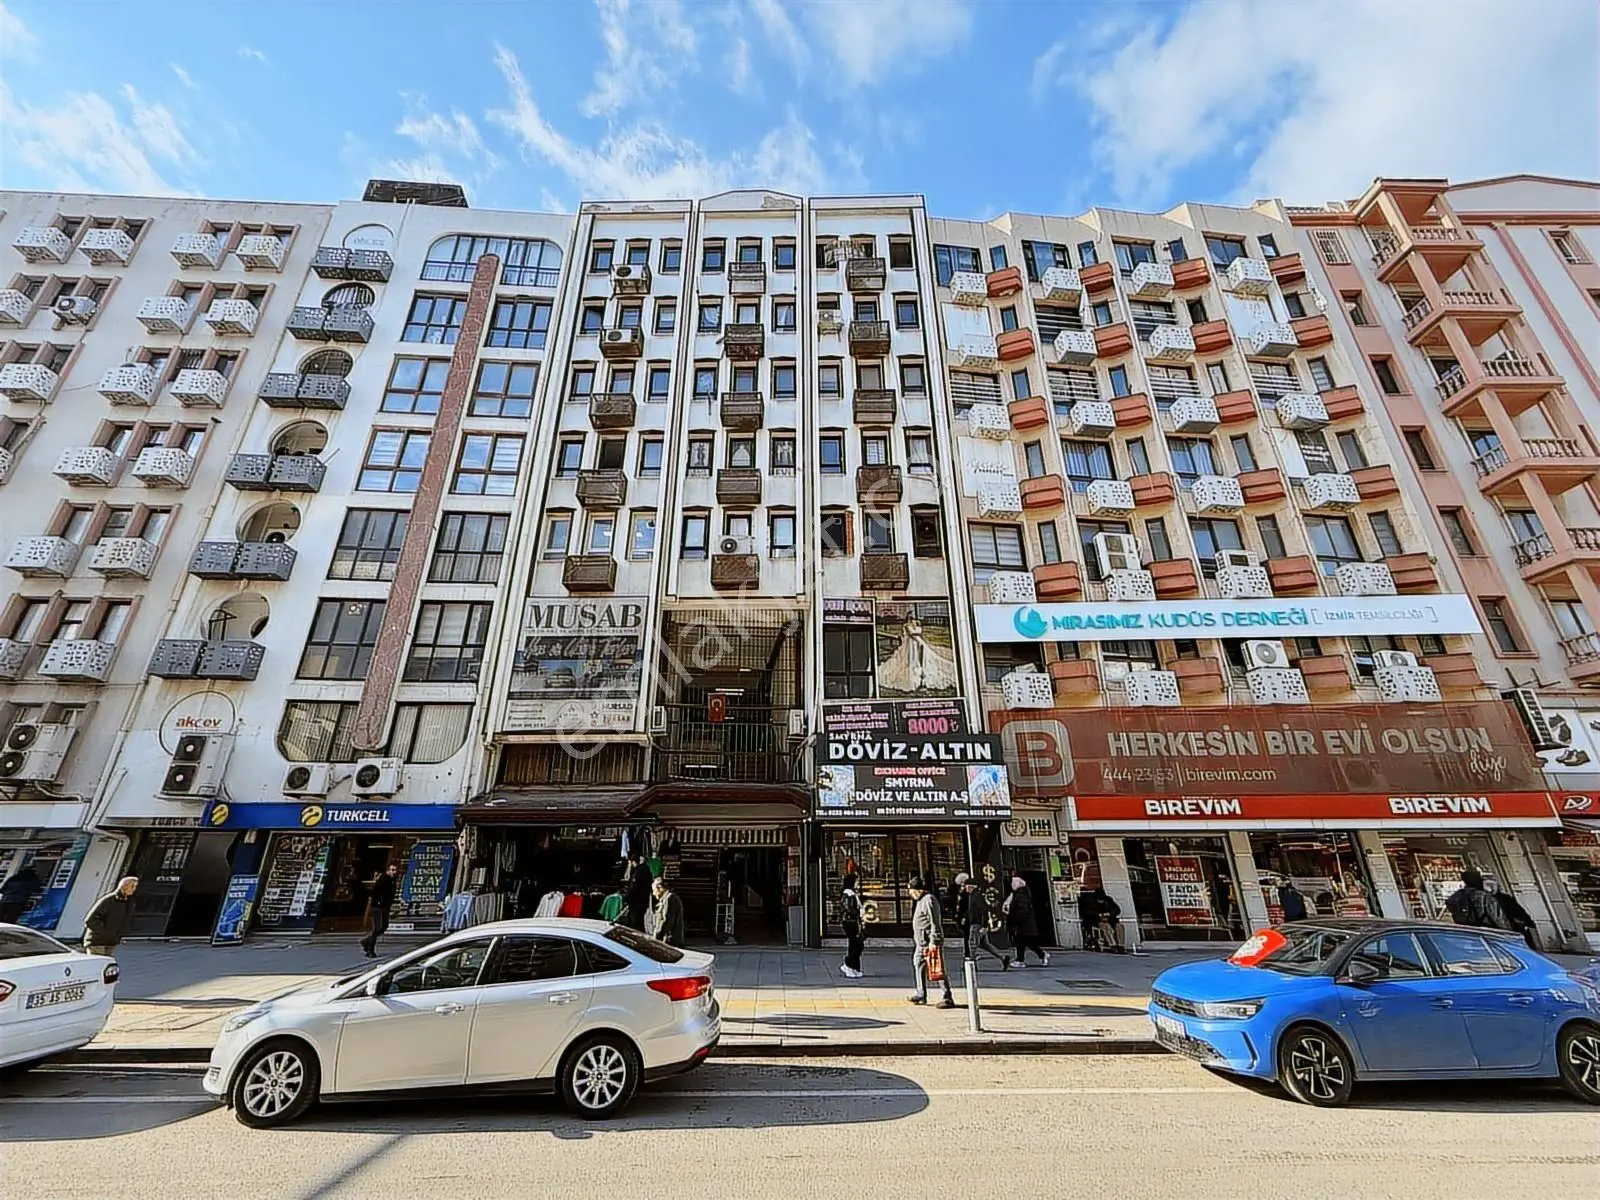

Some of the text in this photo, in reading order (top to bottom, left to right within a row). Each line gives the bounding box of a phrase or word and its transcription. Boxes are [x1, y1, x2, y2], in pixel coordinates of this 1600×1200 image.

[526, 604, 642, 628] MUSAB
[1149, 611, 1216, 627] KUDÜS
[1222, 607, 1309, 627] DERNEĞİ
[1107, 722, 1494, 757] HERKESİN BİR EVİ OLSUN
[829, 739, 908, 760] DÖVİZ
[920, 742, 992, 760] ALTIN
[1103, 767, 1132, 781] 444
[1134, 767, 1153, 781] 23
[1185, 767, 1277, 781] birevim.com
[885, 777, 934, 788] SMYRNA
[856, 789, 893, 802] DÖVİZ
[895, 791, 910, 801] VE
[913, 791, 948, 802] ALTIN
[327, 810, 390, 822] TURKCELL
[412, 875, 443, 887] 12 AY
